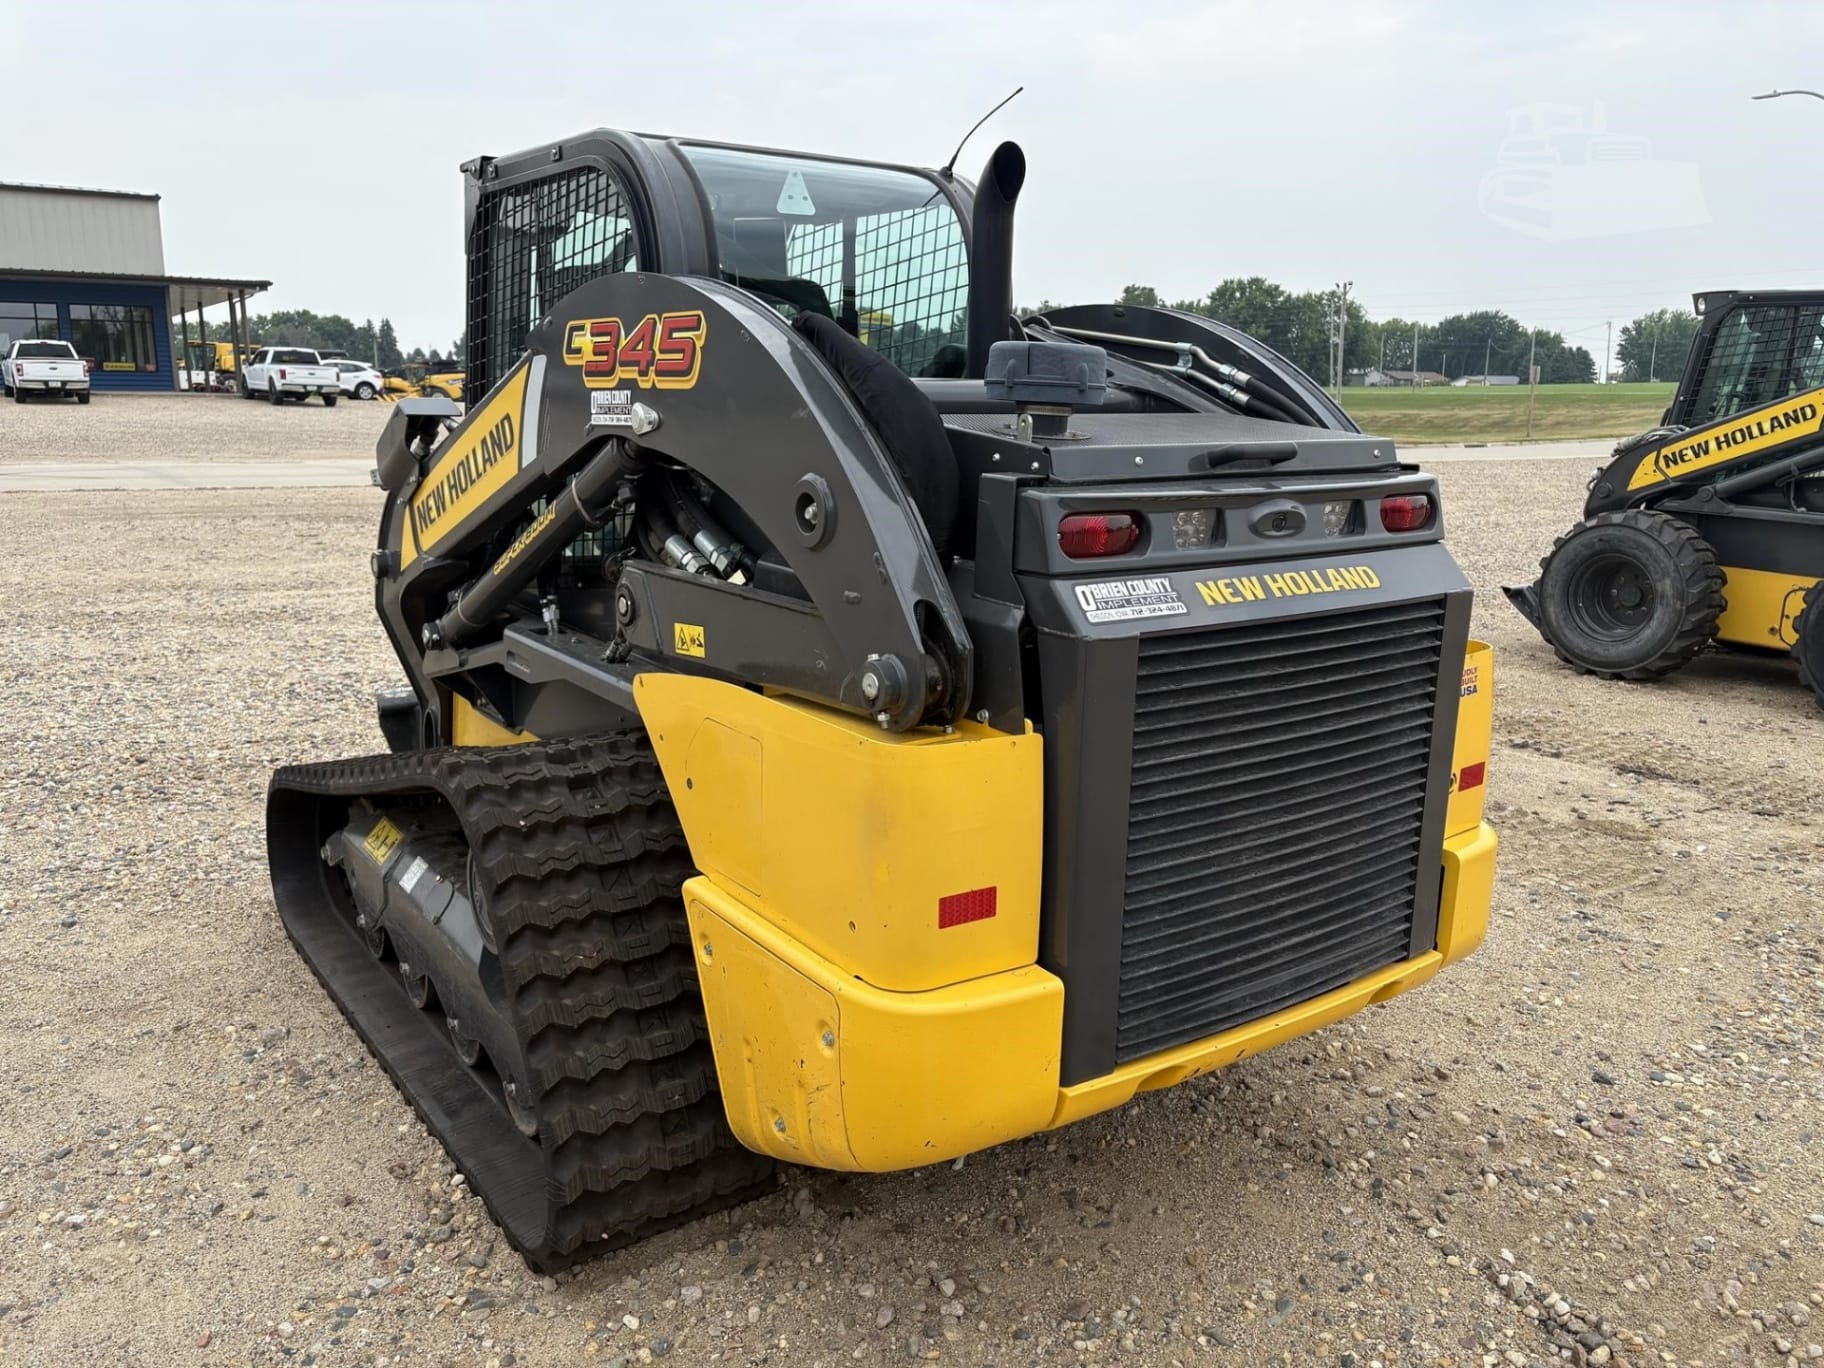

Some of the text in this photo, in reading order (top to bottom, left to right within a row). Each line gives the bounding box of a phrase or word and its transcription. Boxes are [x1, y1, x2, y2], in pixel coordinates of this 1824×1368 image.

[563, 310, 707, 389] C345
[1662, 403, 1817, 469] NEW HOLLAND
[417, 412, 515, 534] NEW HOLLAND
[1075, 578, 1172, 611] O'BRIEN COUNTY
[1096, 595, 1178, 610] IMPLEMENT
[1195, 566, 1381, 606] NEW HOLLAND
